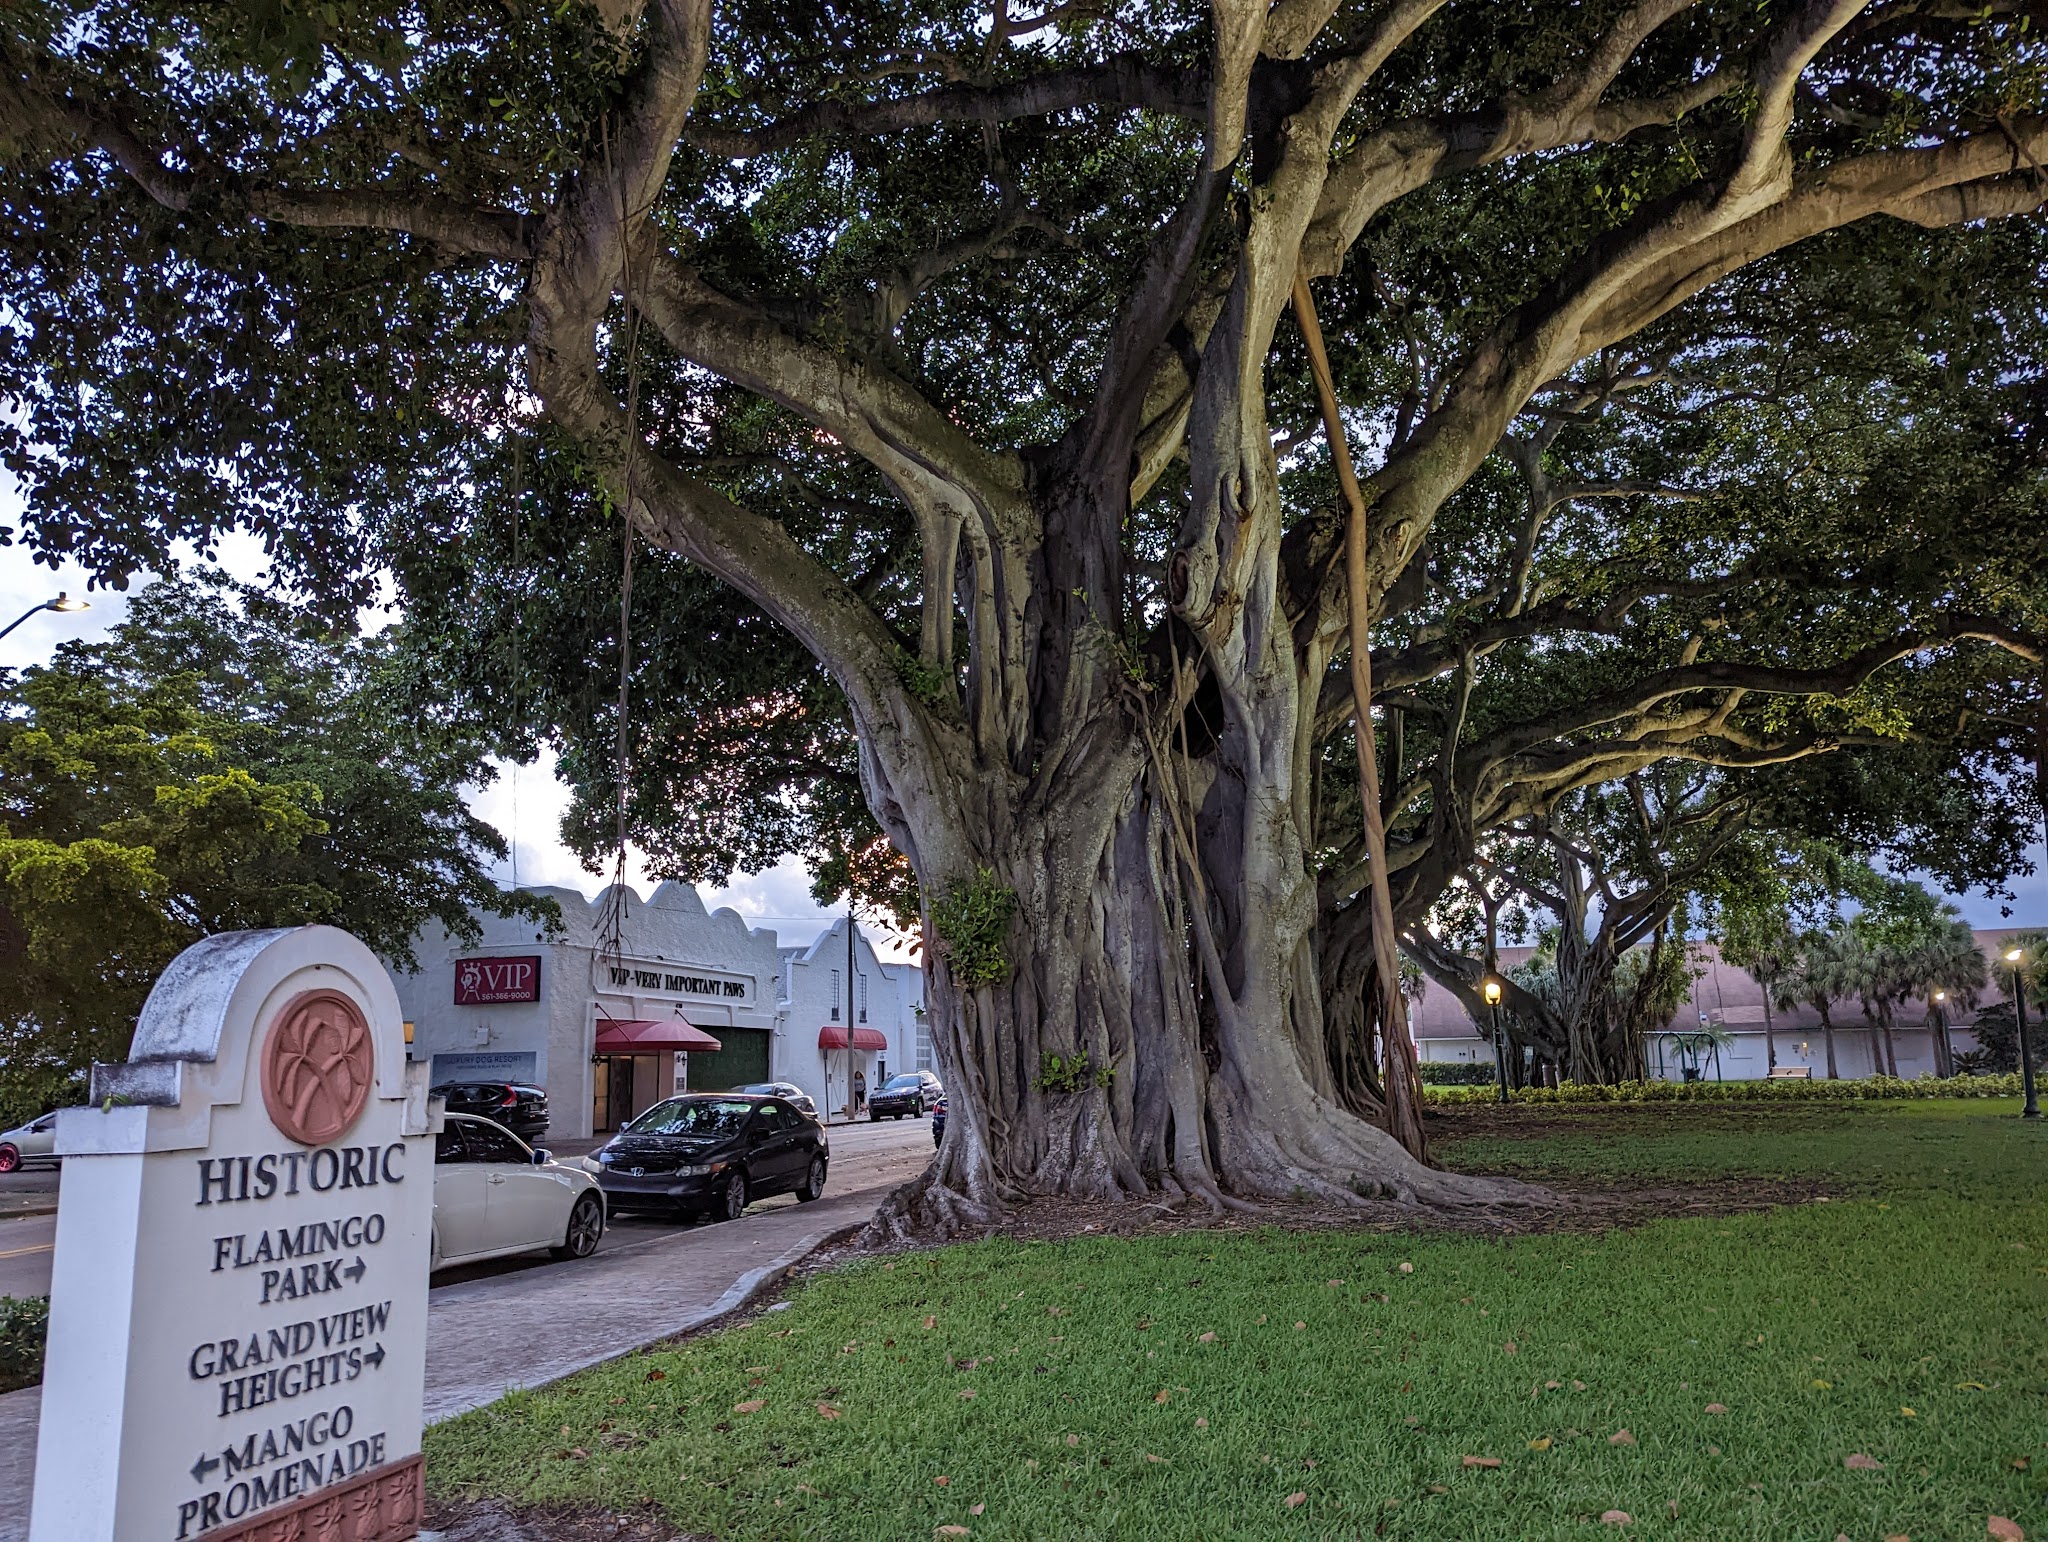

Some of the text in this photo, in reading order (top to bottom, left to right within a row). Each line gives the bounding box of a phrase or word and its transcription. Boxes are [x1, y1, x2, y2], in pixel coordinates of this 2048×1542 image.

[483, 963, 531, 990] VIP
[665, 974, 721, 996] IMPORTANT
[723, 981, 745, 998] PAWS
[447, 1055, 522, 1065] LUXURY DOG RESORT
[195, 1143, 406, 1207] HISTORIC
[210, 1213, 385, 1272] FLAMINGO
[259, 1258, 344, 1305] PARK
[188, 1301, 392, 1380] GRANDVIEW
[217, 1347, 362, 1418] HEIGHTS
[221, 1405, 354, 1482] MANGO
[175, 1432, 386, 1541] PROMENADE
